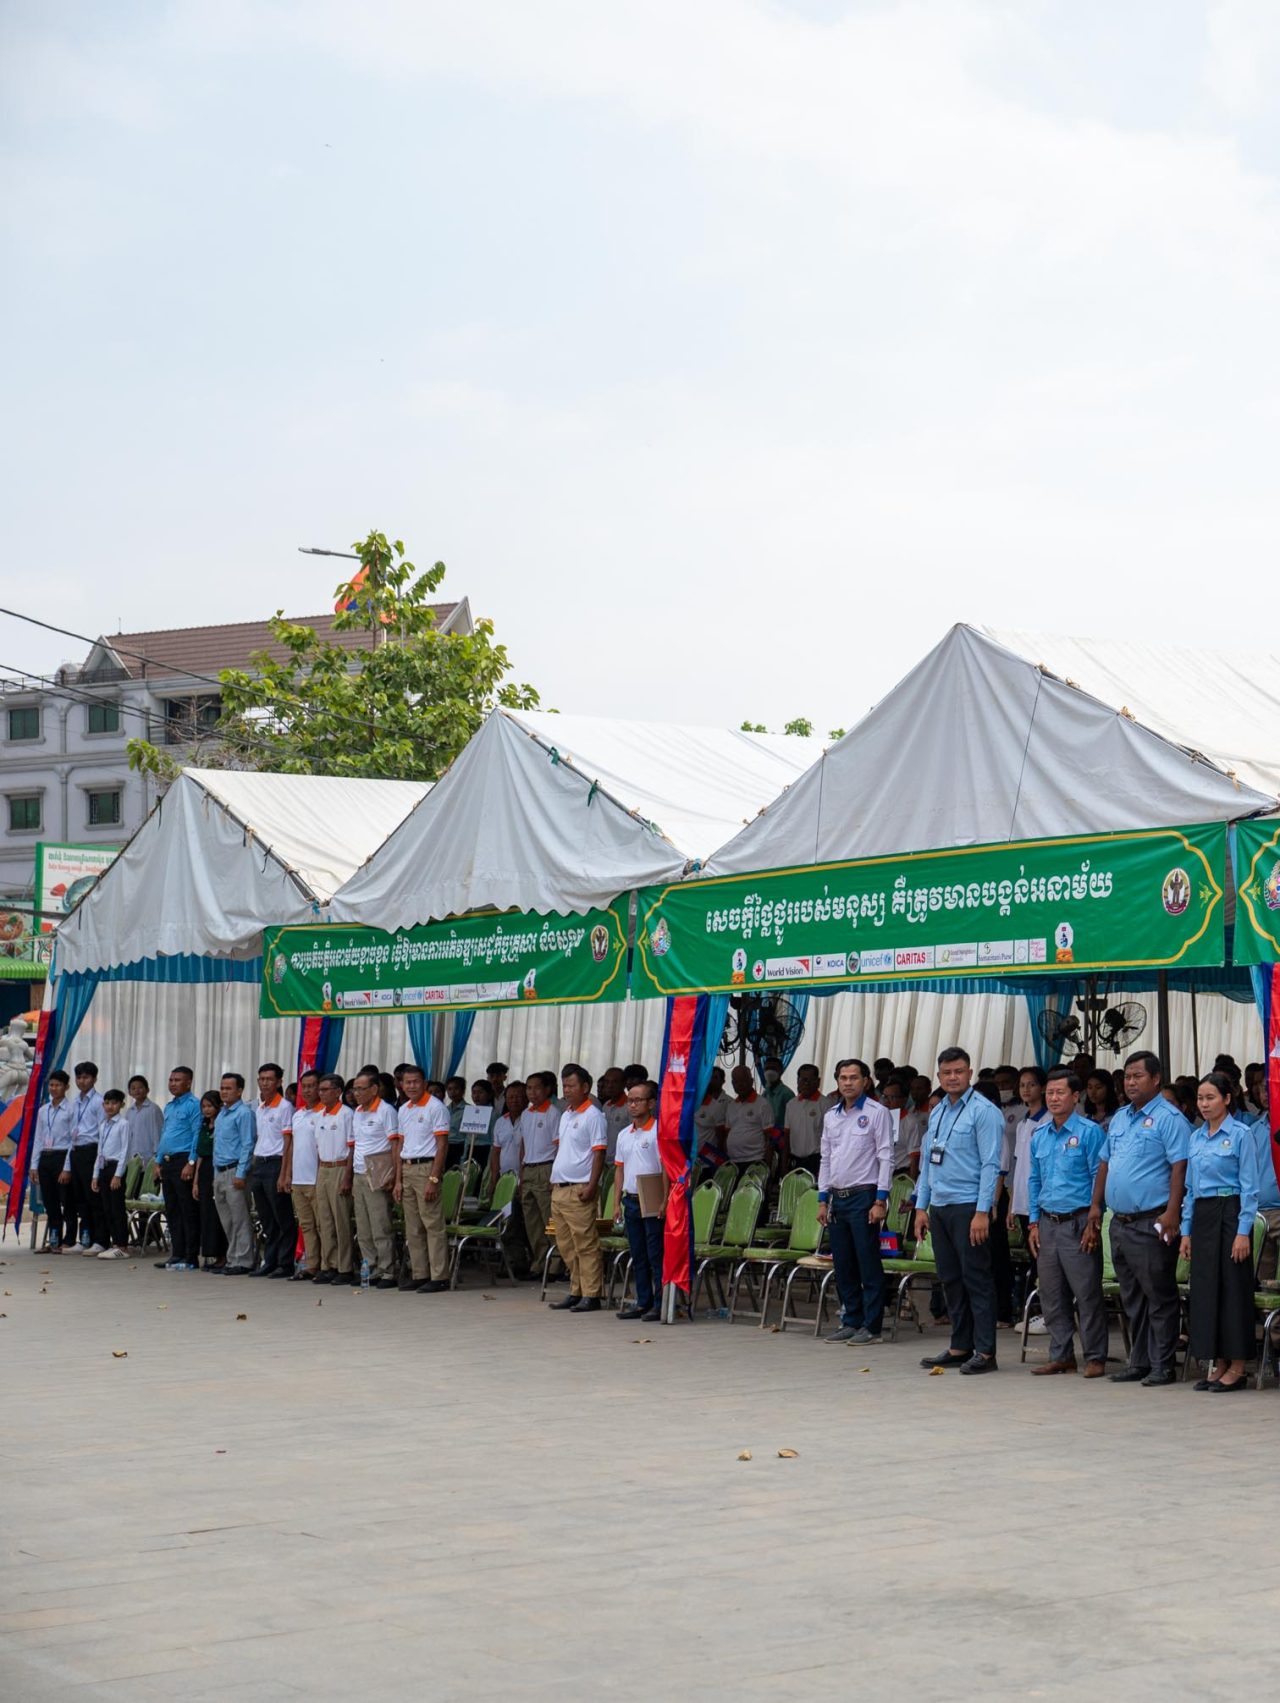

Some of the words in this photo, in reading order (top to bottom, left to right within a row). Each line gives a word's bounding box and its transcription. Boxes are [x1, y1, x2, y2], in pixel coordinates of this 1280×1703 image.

[827, 959, 844, 968] KOICA
[862, 952, 883, 967] unicef
[896, 952, 926, 965] CARITAS
[767, 967, 785, 977] World
[786, 966, 803, 976] Vision
